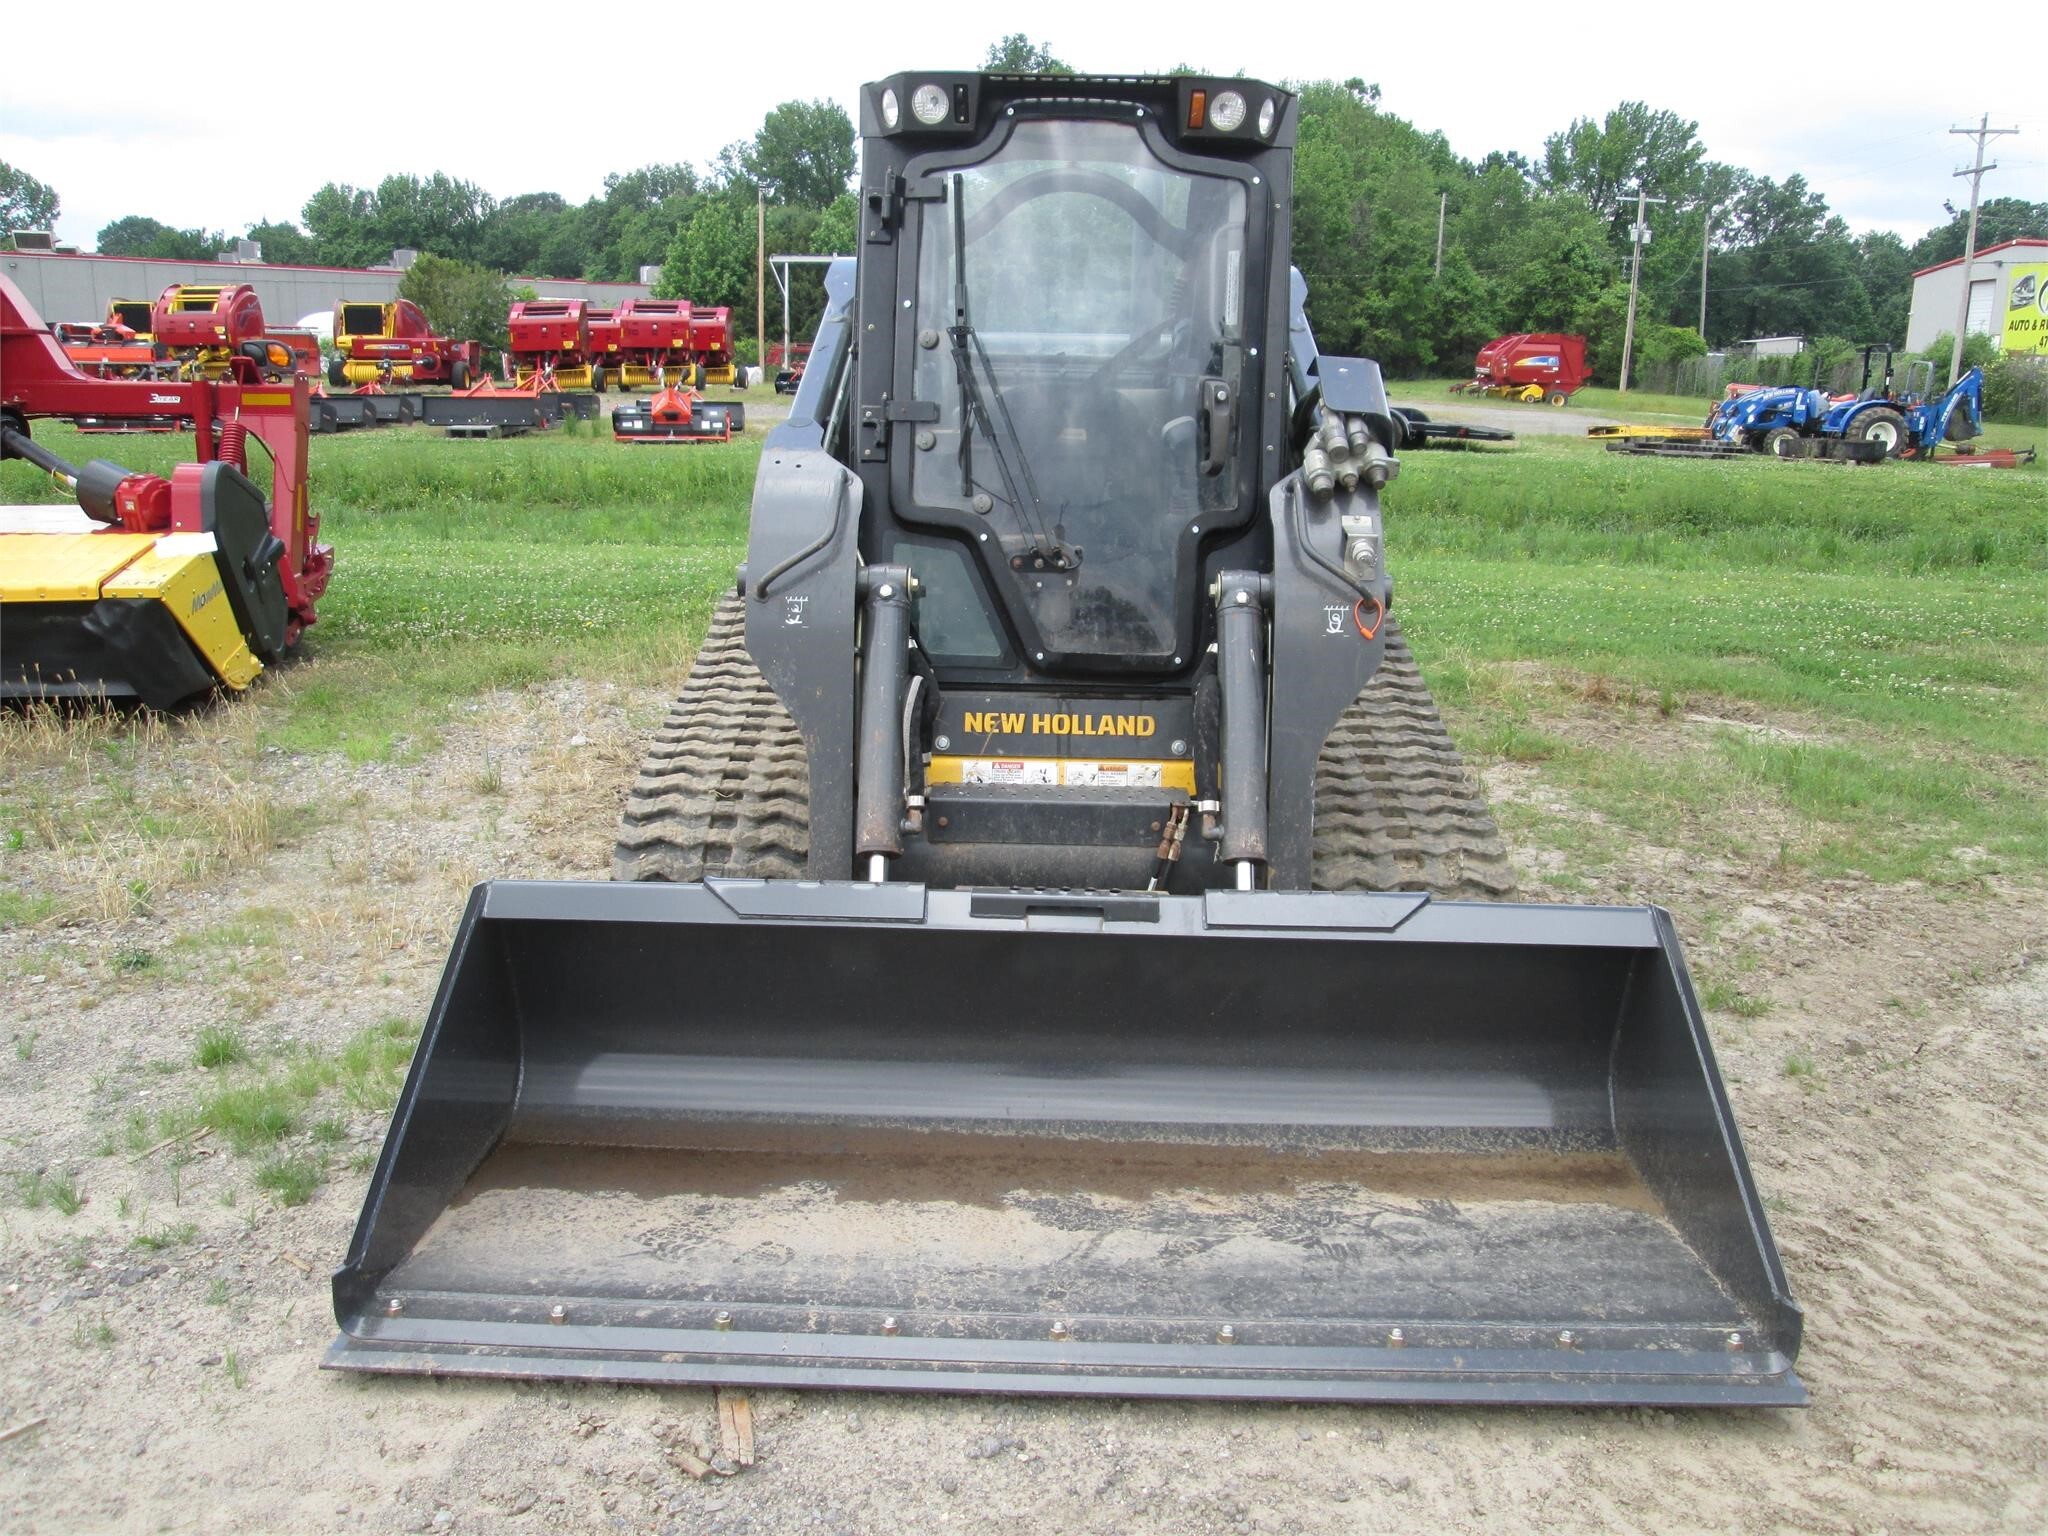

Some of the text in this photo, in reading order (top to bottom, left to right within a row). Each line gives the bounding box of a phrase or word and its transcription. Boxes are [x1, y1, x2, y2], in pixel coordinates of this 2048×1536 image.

[2008, 319, 2030, 331] AUTO
[2031, 319, 2038, 331] &
[964, 712, 1156, 737] NEW HOLLAND
